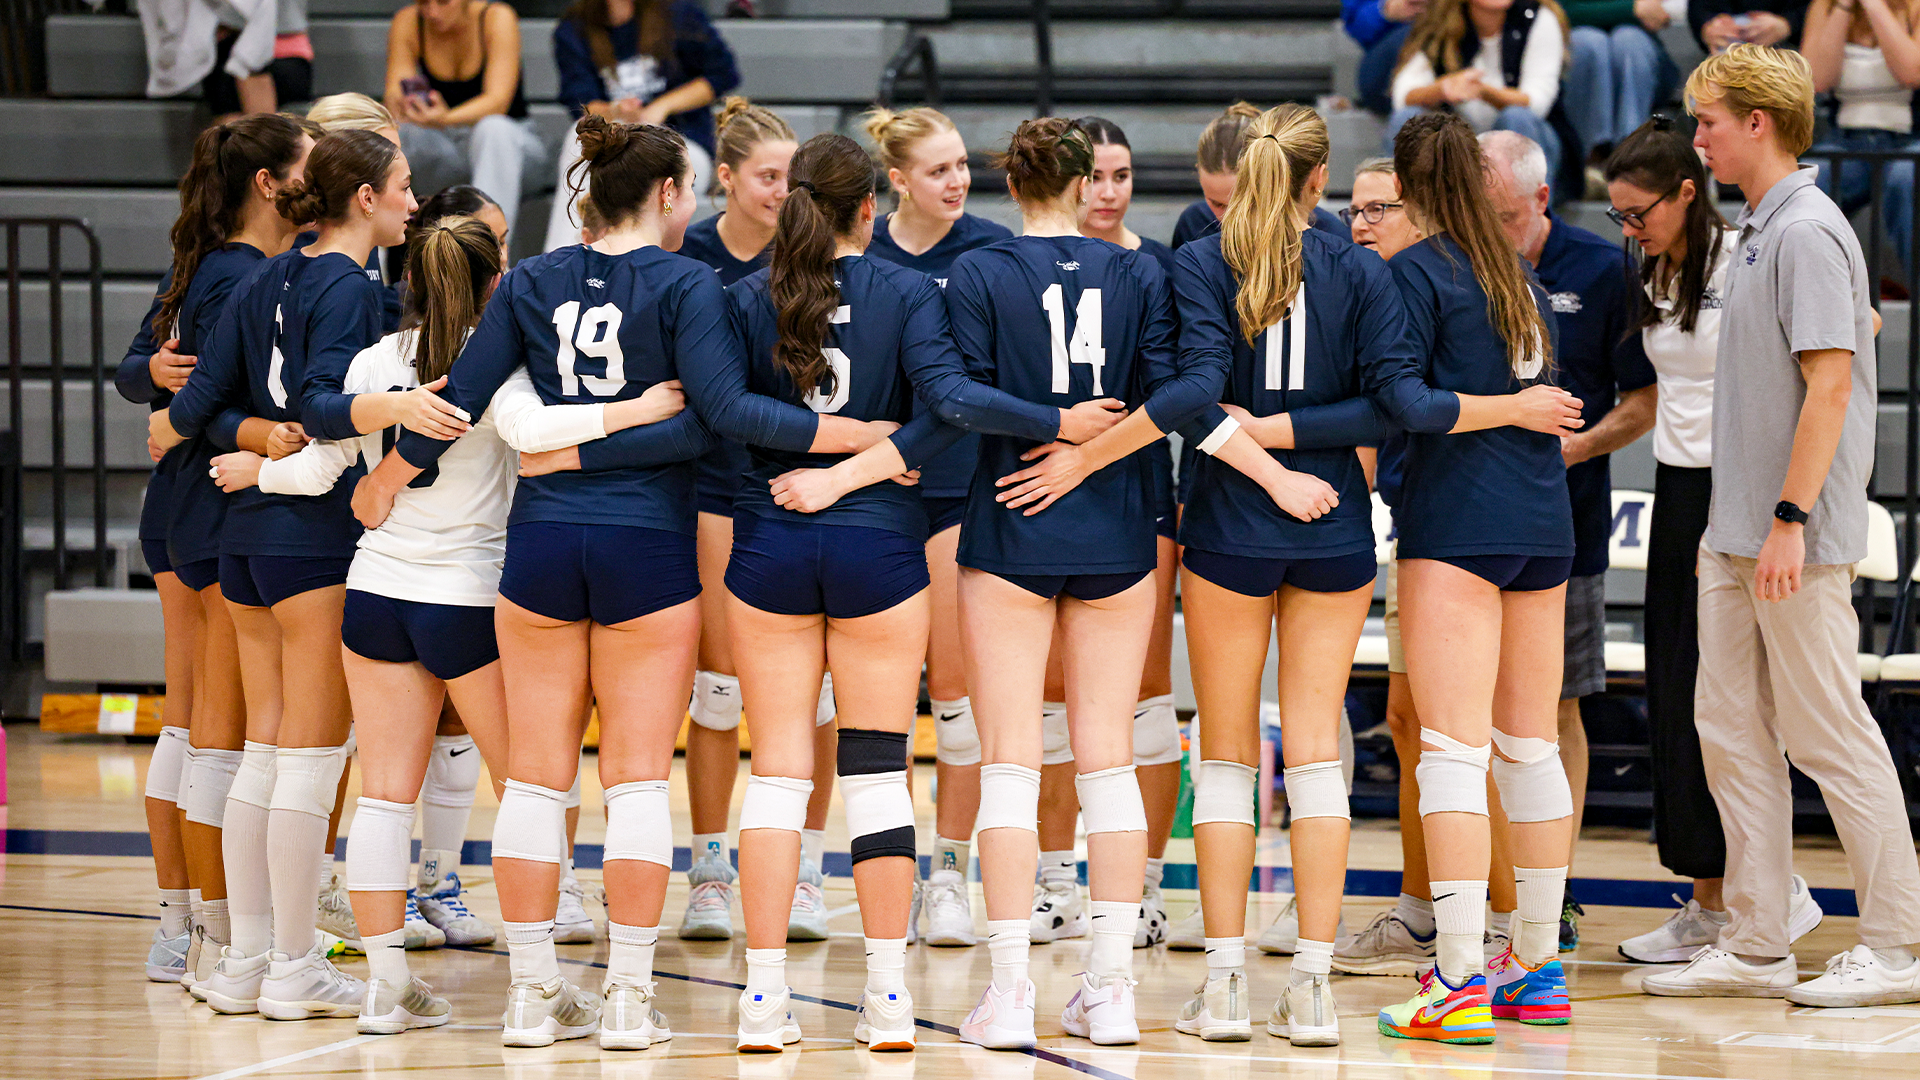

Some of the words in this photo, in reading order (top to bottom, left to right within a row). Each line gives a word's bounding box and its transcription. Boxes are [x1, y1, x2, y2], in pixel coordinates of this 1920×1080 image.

[552, 300, 628, 397] 19
[1042, 283, 1106, 396] 14
[1265, 281, 1306, 390] 11
